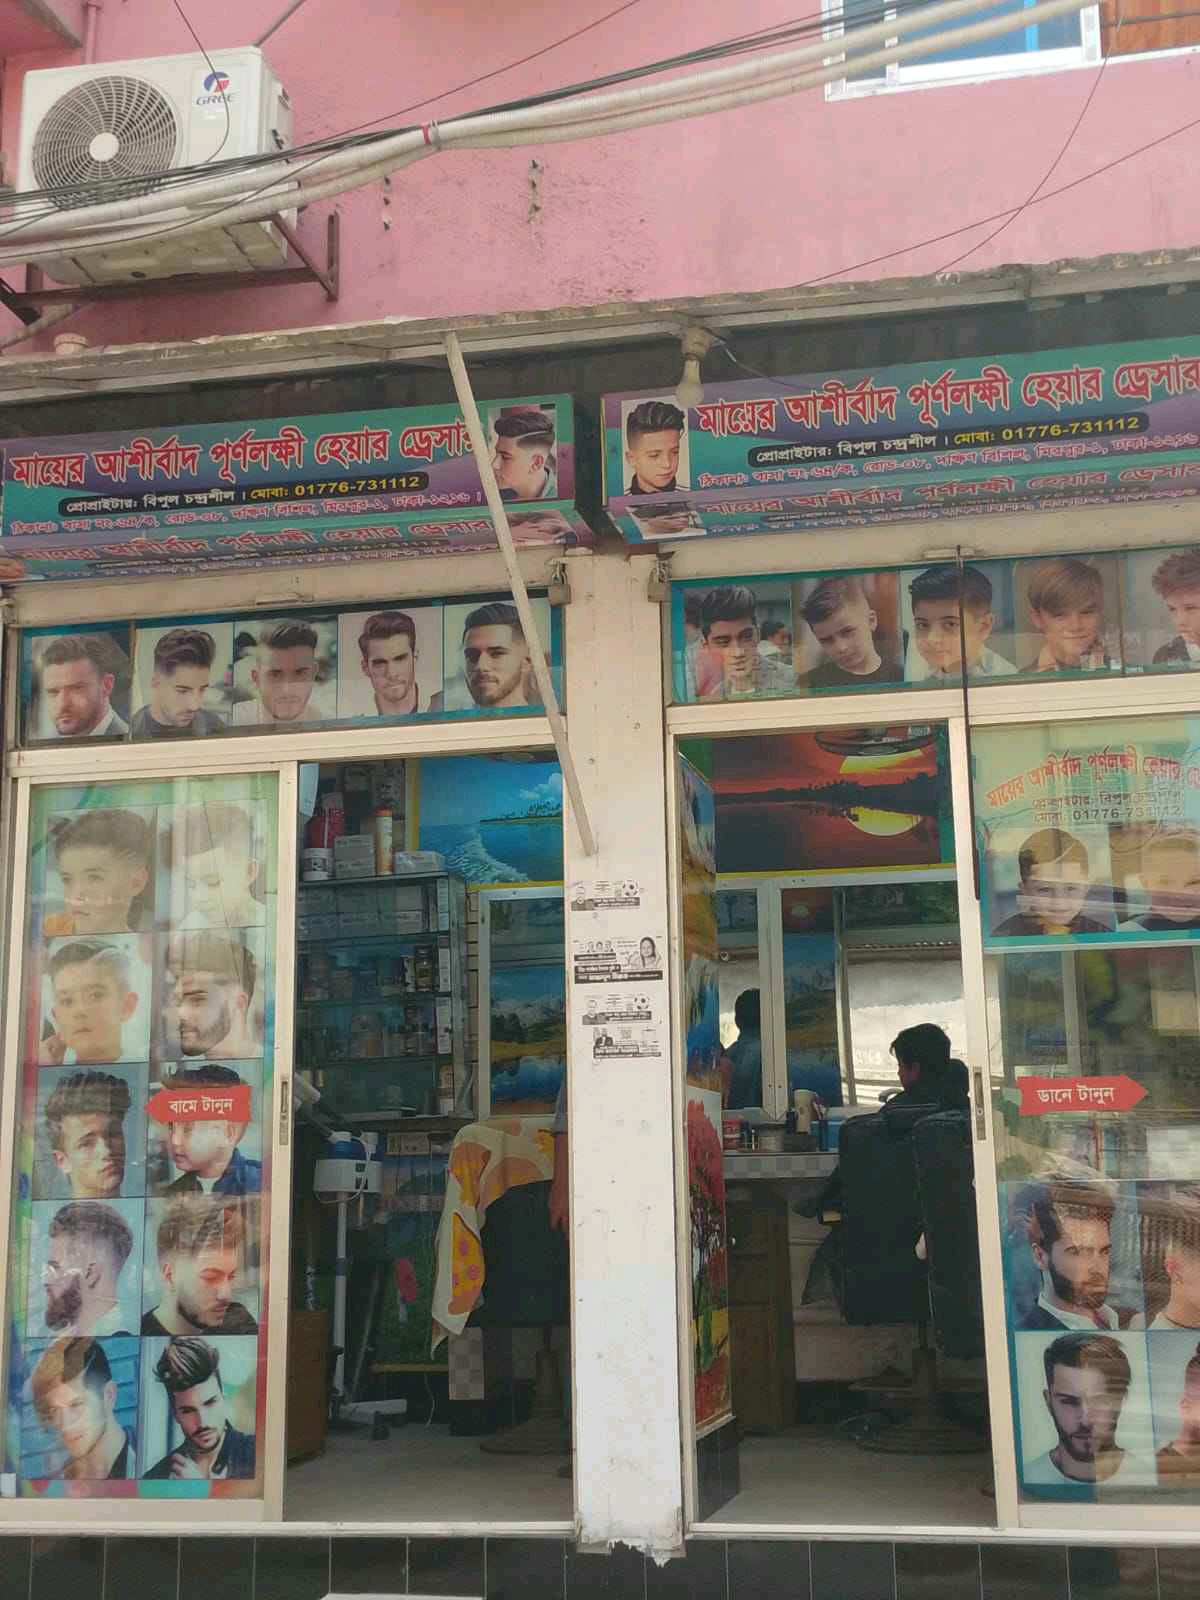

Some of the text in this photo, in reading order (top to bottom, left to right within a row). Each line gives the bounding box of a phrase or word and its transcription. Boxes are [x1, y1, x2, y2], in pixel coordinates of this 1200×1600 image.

[696, 399, 777, 438] মায়ের
[782, 377, 899, 430] আশীর্বাদ
[907, 364, 1012, 428] পূর্ণলক্ষী
[1022, 364, 1104, 411] হেয়ার
[837, 440, 877, 456] বিপুল
[1002, 416, 1140, 441] 01776-731112
[9, 452, 88, 488] মায়ের
[92, 435, 202, 482] আশীর্বাদ
[209, 426, 306, 484] পূর্ণলক্ষী
[314, 425, 391, 469] হেয়ার
[143, 493, 180, 511] বিপুল
[294, 476, 420, 497] 01776-731112
[1027, 749, 1083, 787] আশীর্বাদ
[168, 1096, 234, 1115] বামে টানুন
[1036, 1084, 1115, 1105] ডানে টানুন
